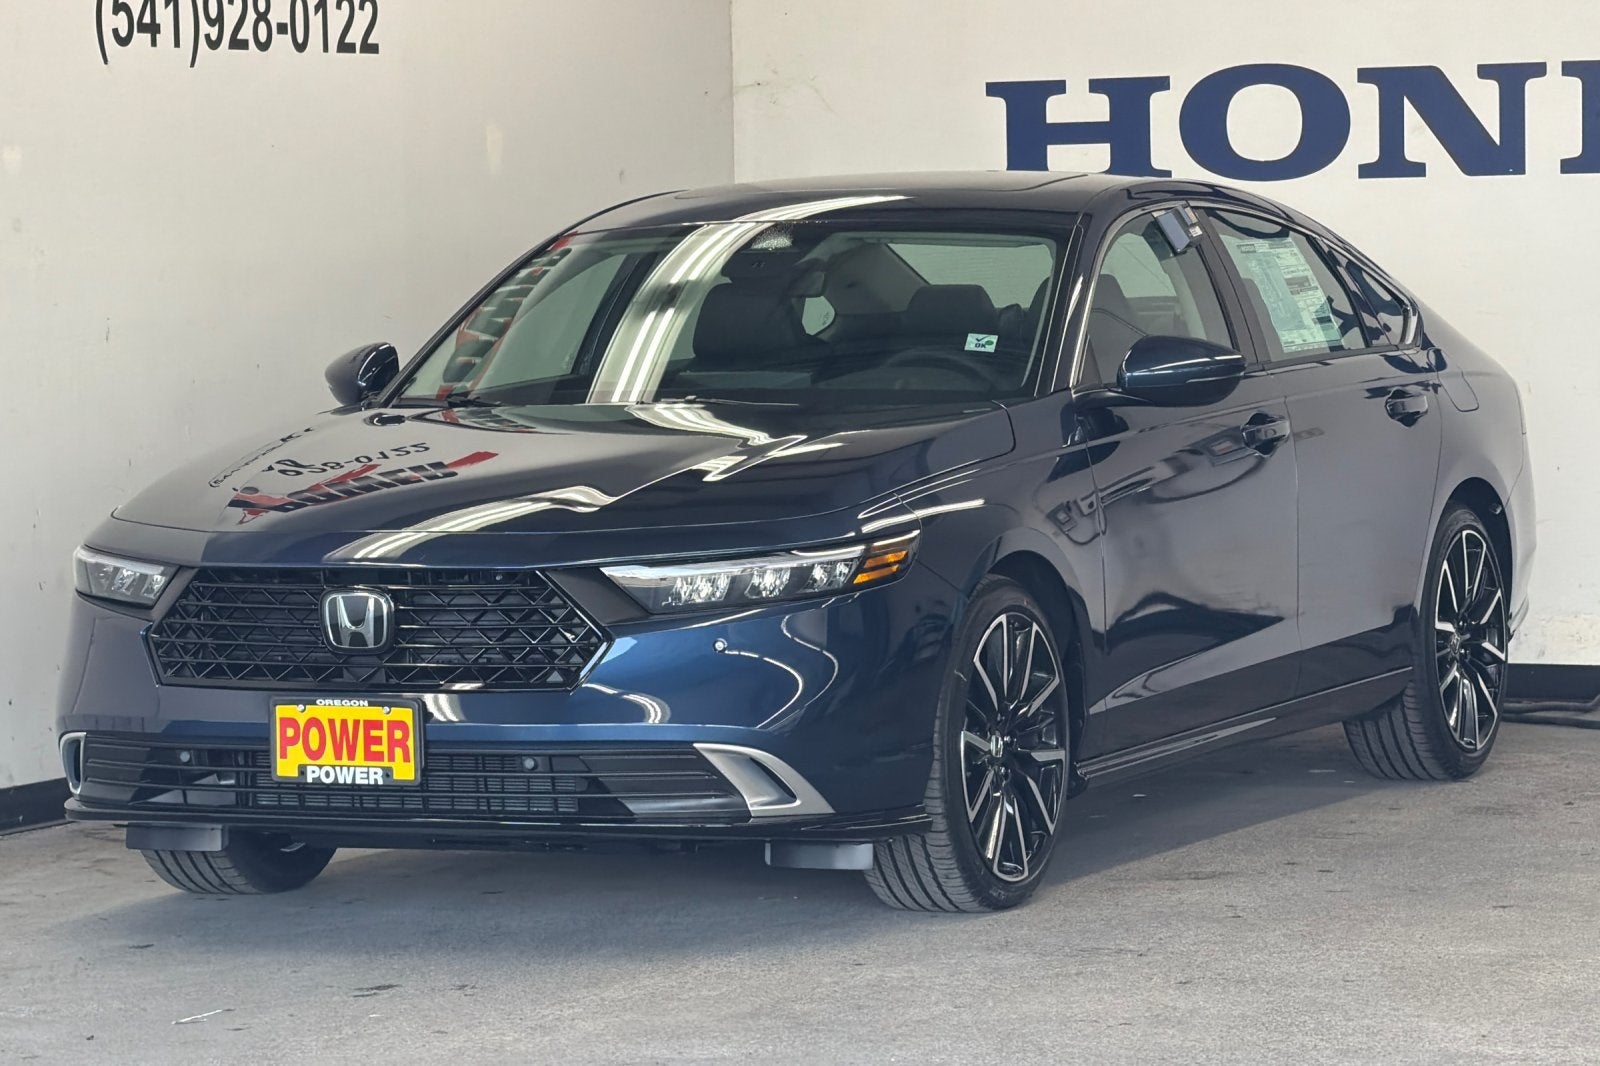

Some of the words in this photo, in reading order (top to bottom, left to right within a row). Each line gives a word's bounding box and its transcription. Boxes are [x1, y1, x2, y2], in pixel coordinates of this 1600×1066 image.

[95, 0, 380, 68] (541)928-0122
[985, 60, 1600, 181] HON
[315, 698, 369, 707] OREGON
[279, 716, 411, 763] POWER
[306, 765, 384, 785] POWER
